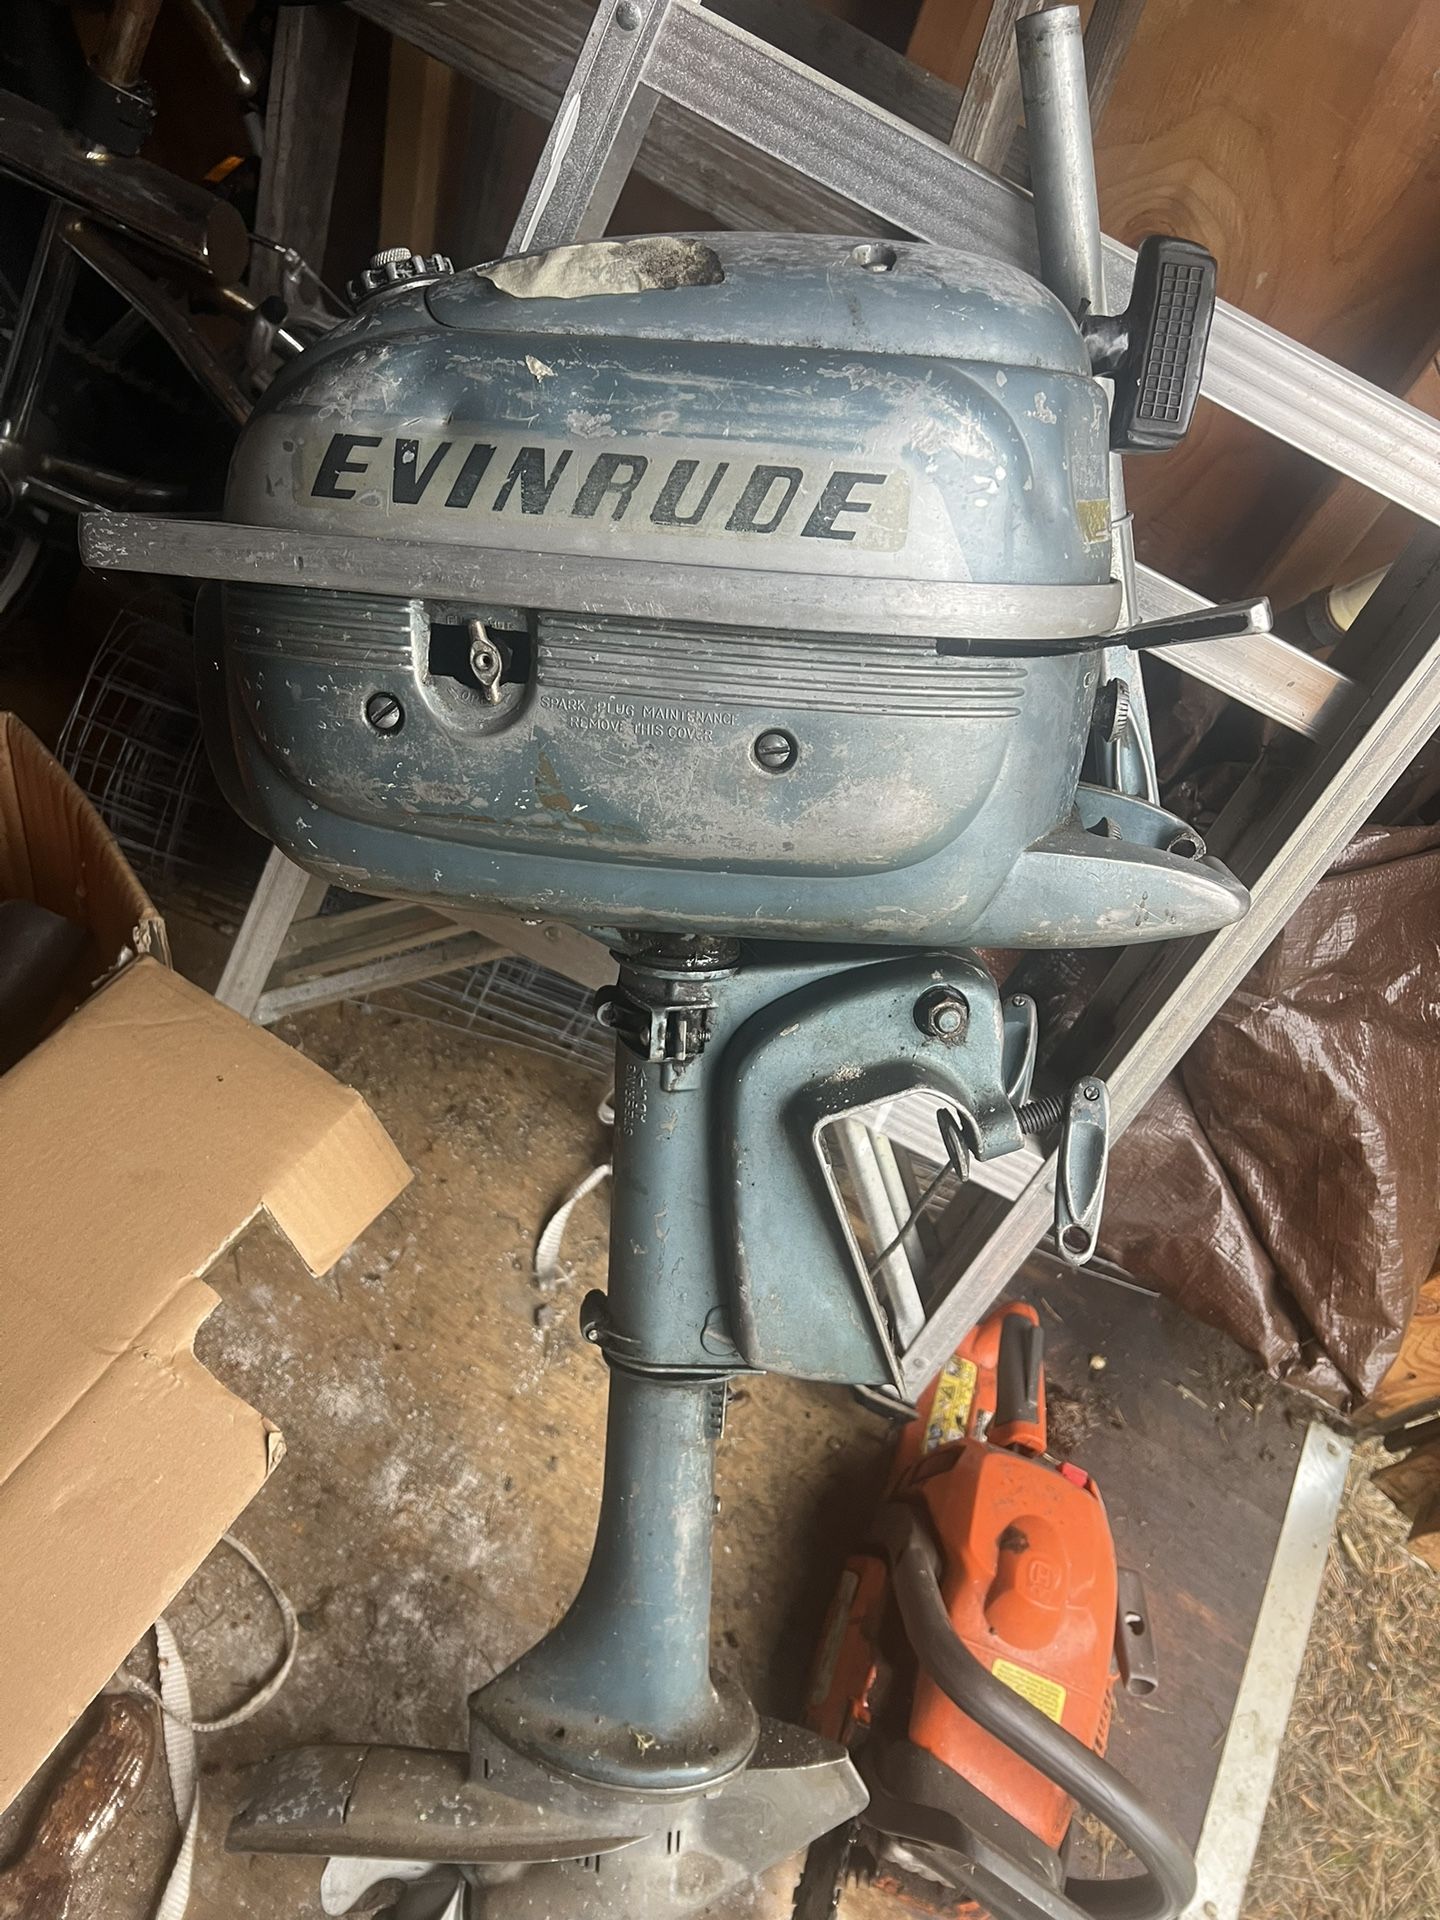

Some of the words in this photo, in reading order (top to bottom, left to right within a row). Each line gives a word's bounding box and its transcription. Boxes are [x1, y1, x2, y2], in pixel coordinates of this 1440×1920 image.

[310, 433, 888, 541] EVINRUDE
[540, 694, 586, 712] SPARK
[597, 701, 635, 717] PLUG
[642, 705, 738, 726] MAINTENANCE
[570, 716, 627, 734] REMOVE
[633, 721, 664, 738] THIS
[668, 725, 714, 741] COVER
[623, 1063, 637, 1137] STEERING
